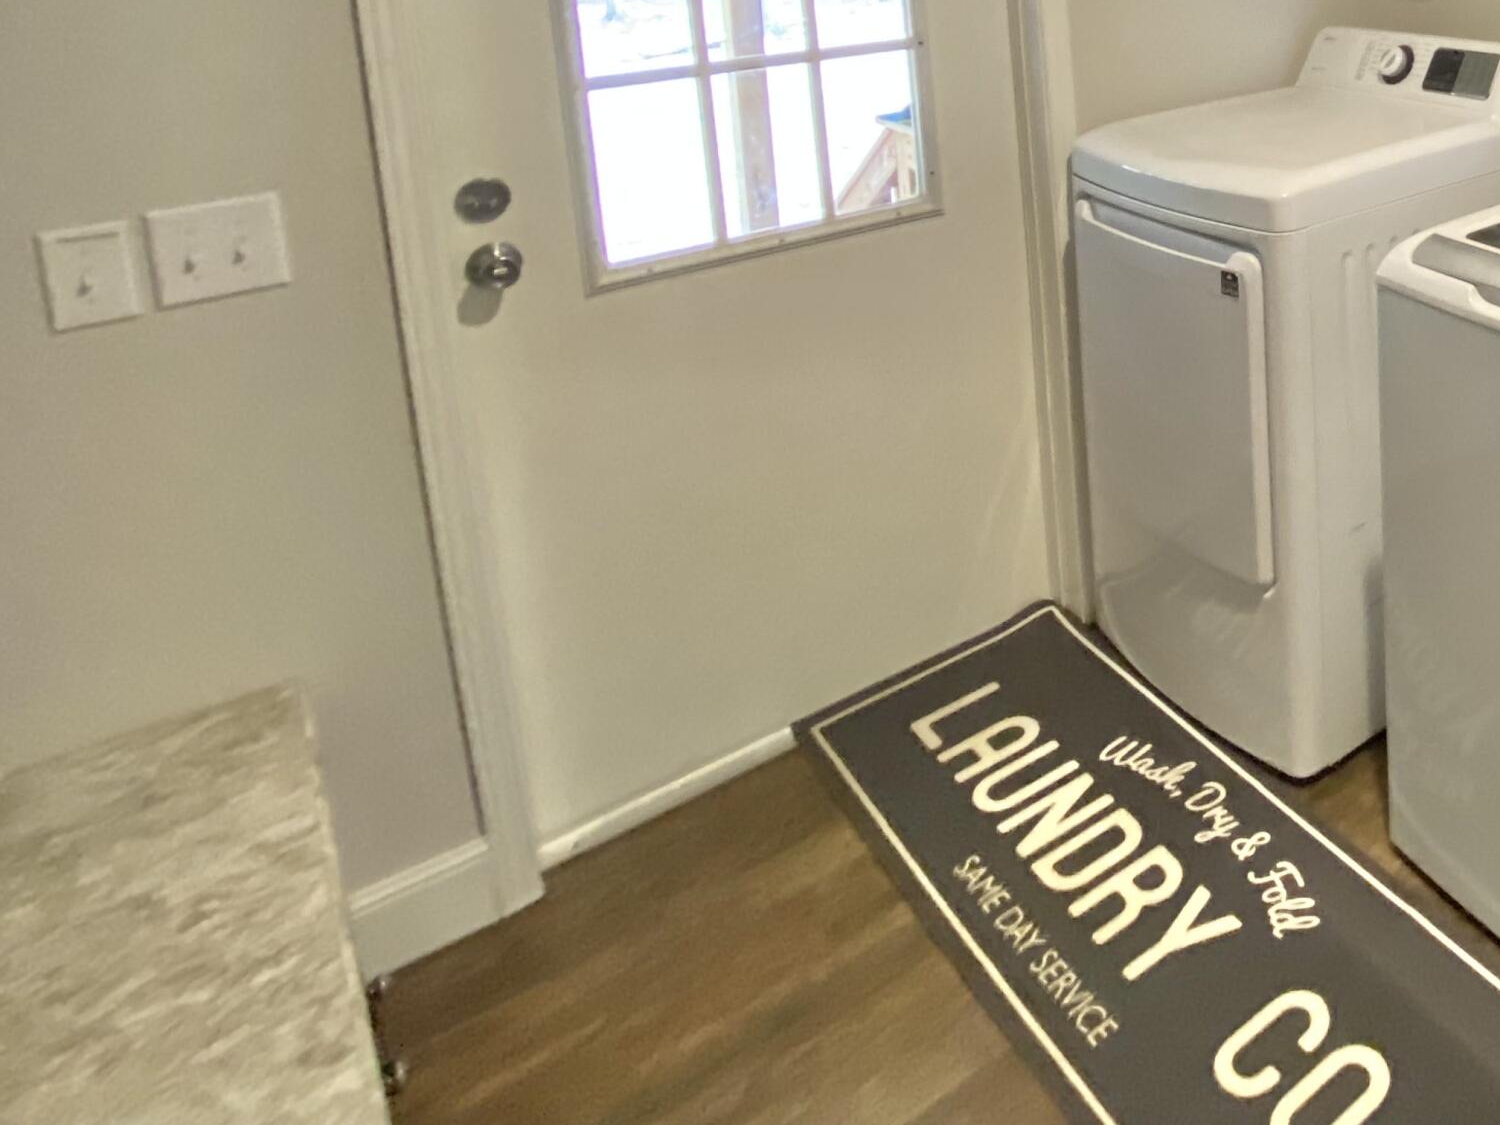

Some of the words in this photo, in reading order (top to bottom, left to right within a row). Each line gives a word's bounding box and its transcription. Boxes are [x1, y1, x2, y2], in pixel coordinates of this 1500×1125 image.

[1099, 735, 1197, 798] Wash,
[910, 681, 1242, 981] LAUNDRY
[1184, 781, 1240, 843] Dry
[1231, 831, 1271, 861] &
[1247, 861, 1320, 940] Fold
[953, 854, 1012, 915] SAME
[994, 904, 1048, 956] DAY
[1029, 949, 1120, 1048] SERVICE
